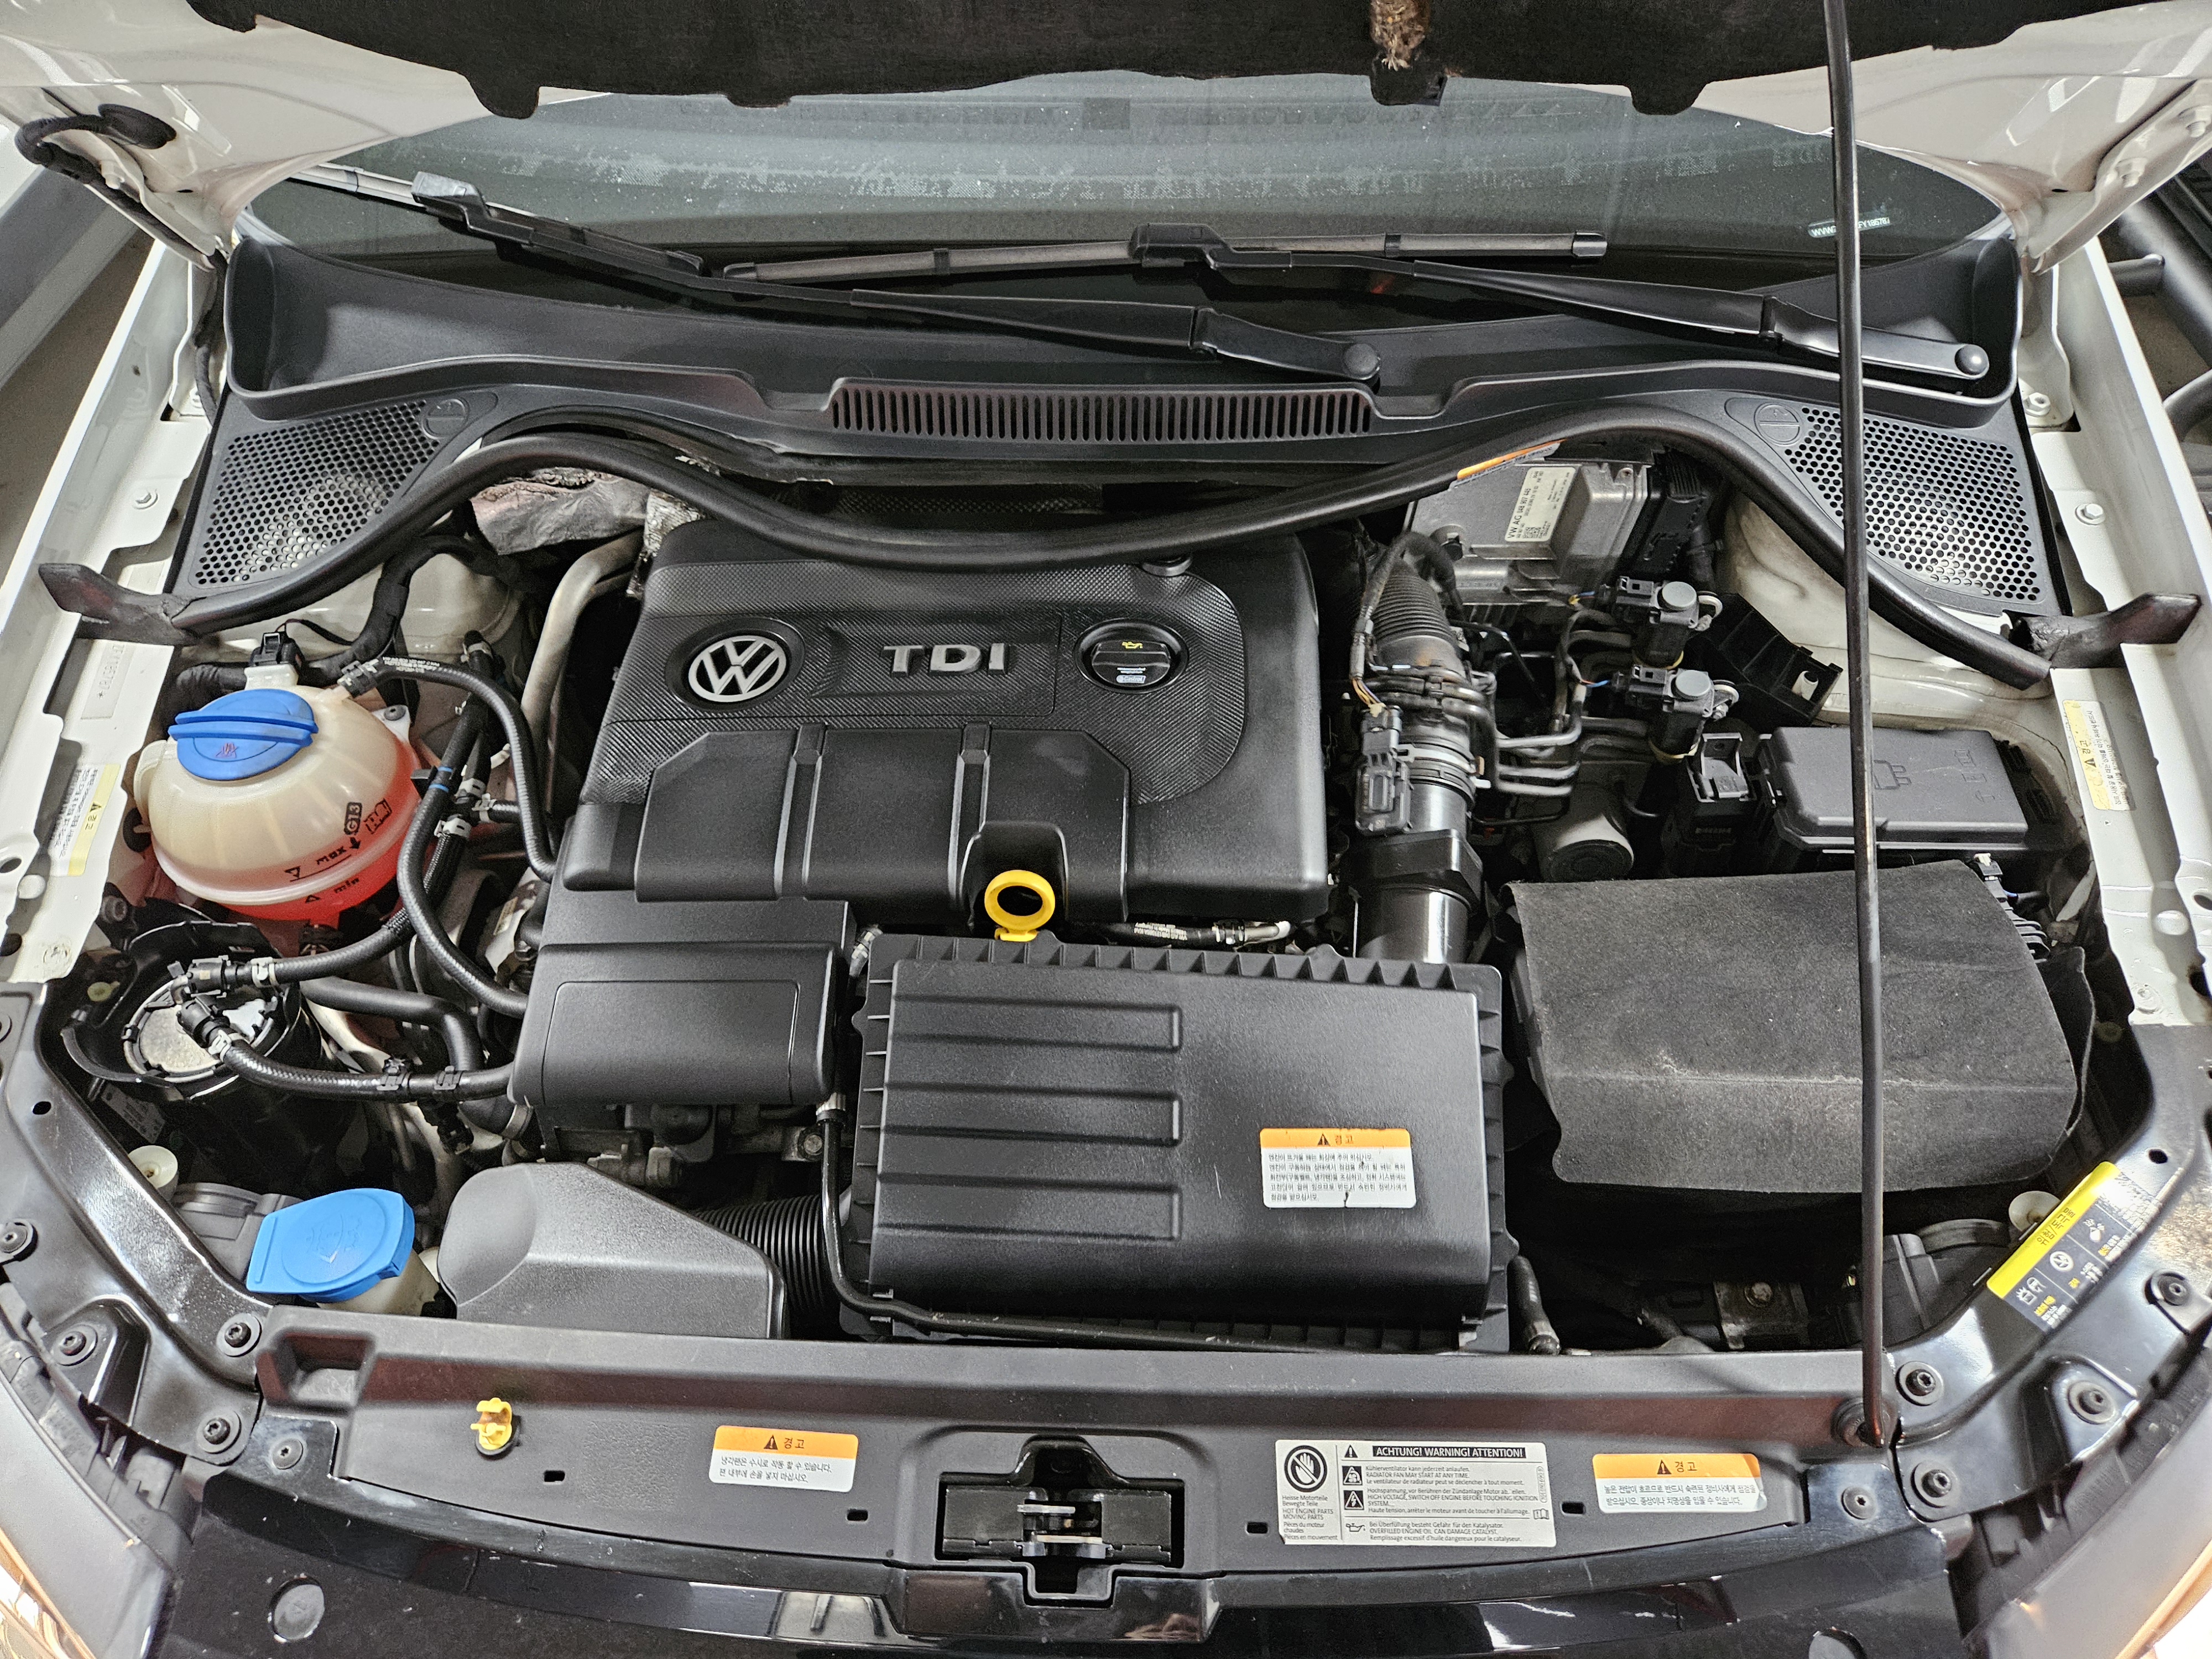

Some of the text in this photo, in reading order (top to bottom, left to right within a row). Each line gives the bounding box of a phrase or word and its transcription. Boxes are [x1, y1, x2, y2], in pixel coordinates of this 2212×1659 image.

[1508, 526, 1518, 539] VW
[1514, 515, 1522, 525] AG
[883, 643, 1005, 673] TDI
[688, 635, 786, 702] VW
[2085, 740, 2096, 754] 경고
[347, 805, 360, 832] G13
[316, 846, 347, 865] max
[334, 878, 359, 893] min
[784, 1437, 805, 1449] 경고
[1376, 1447, 1524, 1458] ACHTUNG! WARNING! ATTENTION!
[1674, 1461, 1698, 1473] 경고
